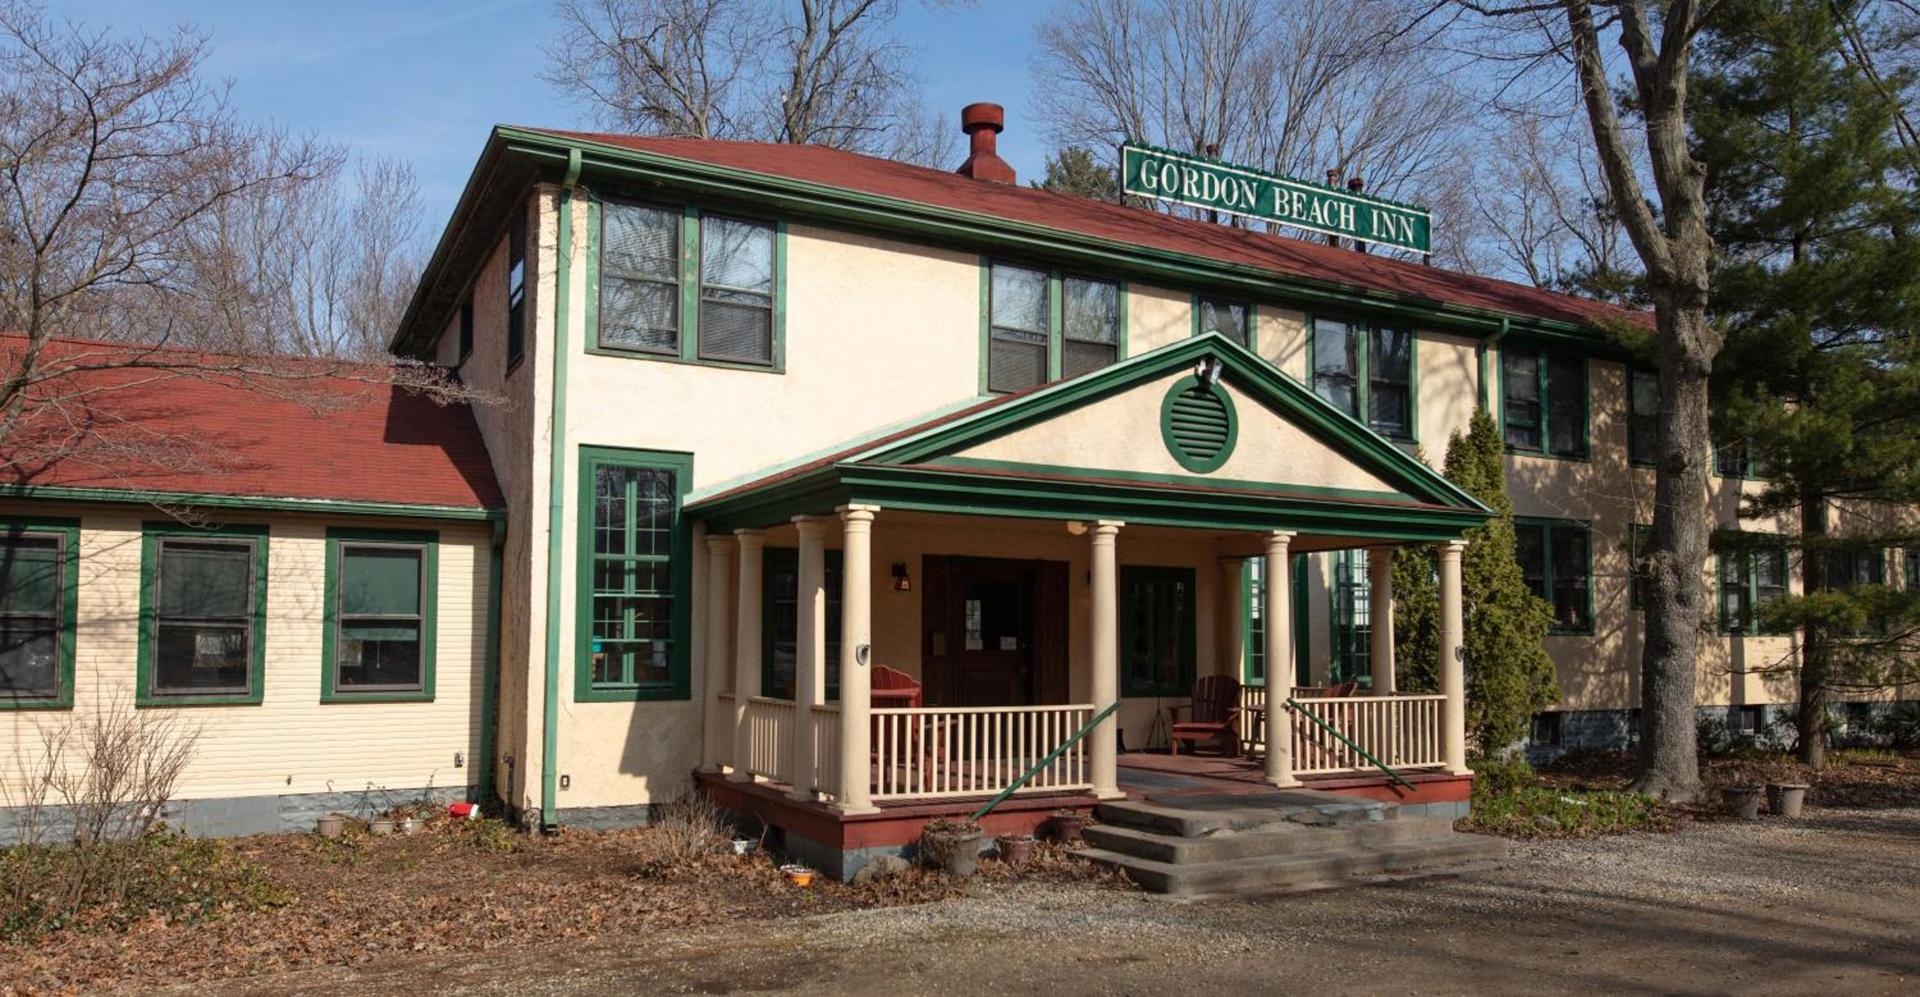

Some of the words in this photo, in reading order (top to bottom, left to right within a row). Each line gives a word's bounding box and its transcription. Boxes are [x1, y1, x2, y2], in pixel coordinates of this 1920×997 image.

[1140, 159, 1257, 209] GORDON
[1273, 187, 1357, 231] BEACH
[1371, 209, 1415, 243] INN
